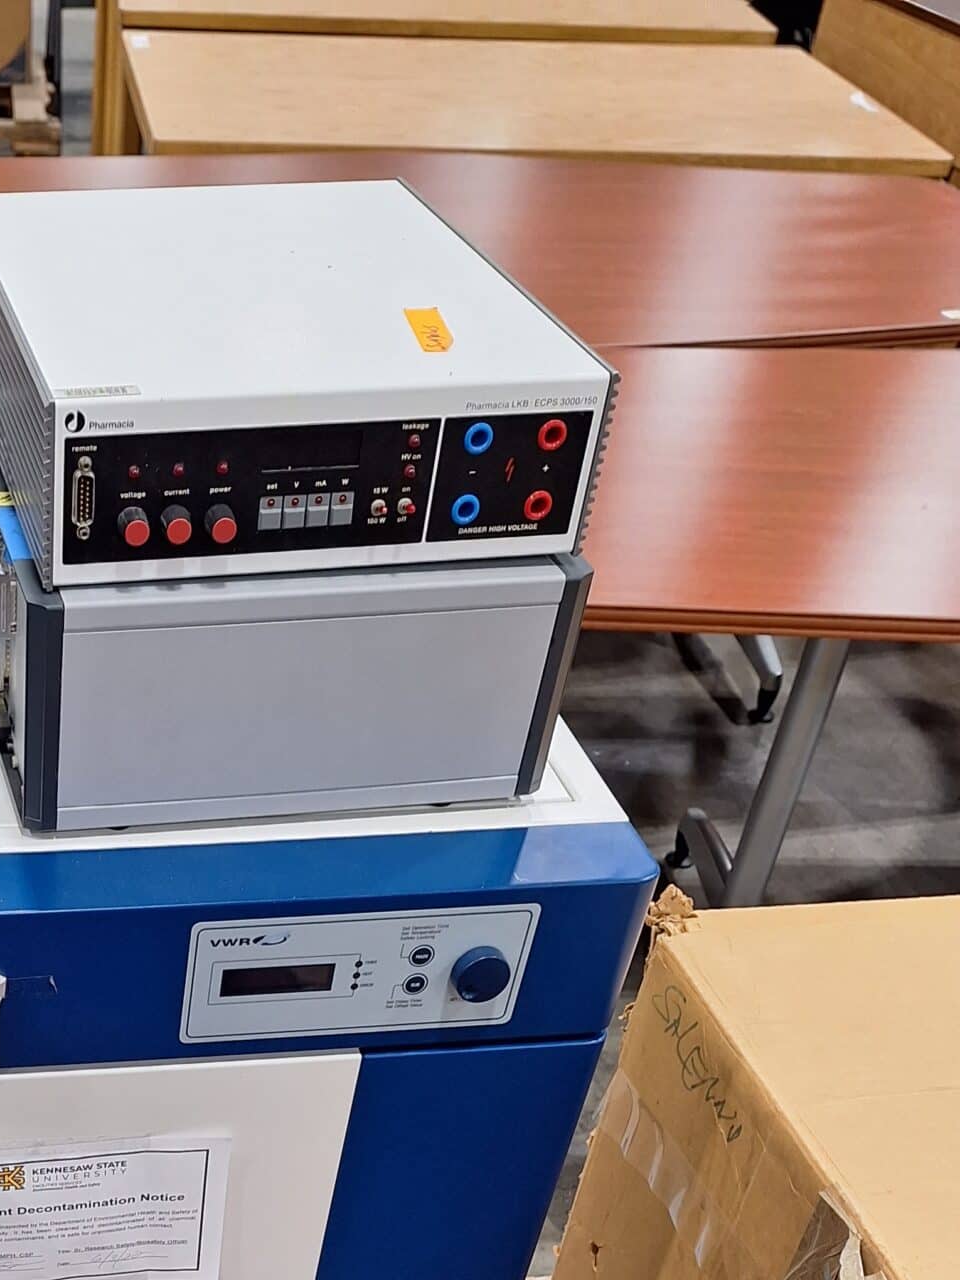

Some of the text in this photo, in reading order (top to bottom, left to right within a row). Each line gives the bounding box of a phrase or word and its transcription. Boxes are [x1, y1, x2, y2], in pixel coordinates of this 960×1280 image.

[465, 401, 510, 411] Pharmacia
[511, 399, 529, 408] LKB
[534, 398, 558, 407] ECPS
[89, 420, 135, 431] Pharmacia
[402, 423, 430, 431] leakage
[71, 444, 98, 453] remote
[266, 482, 278, 490] set
[294, 481, 300, 489] V
[315, 479, 327, 488] mA
[341, 477, 350, 486] W
[120, 490, 146, 500] voltage
[164, 488, 190, 497] current
[209, 485, 232, 495] power
[458, 522, 538, 535] DANGER HIGH VOLTAGE
[210, 936, 251, 948] VWR
[32, 1160, 127, 1175] KENNESAW STATE
[32, 1168, 127, 1183] UNIVERSITY
[17, 1195, 136, 1216] Decontamination
[140, 1193, 185, 1202] Notice
